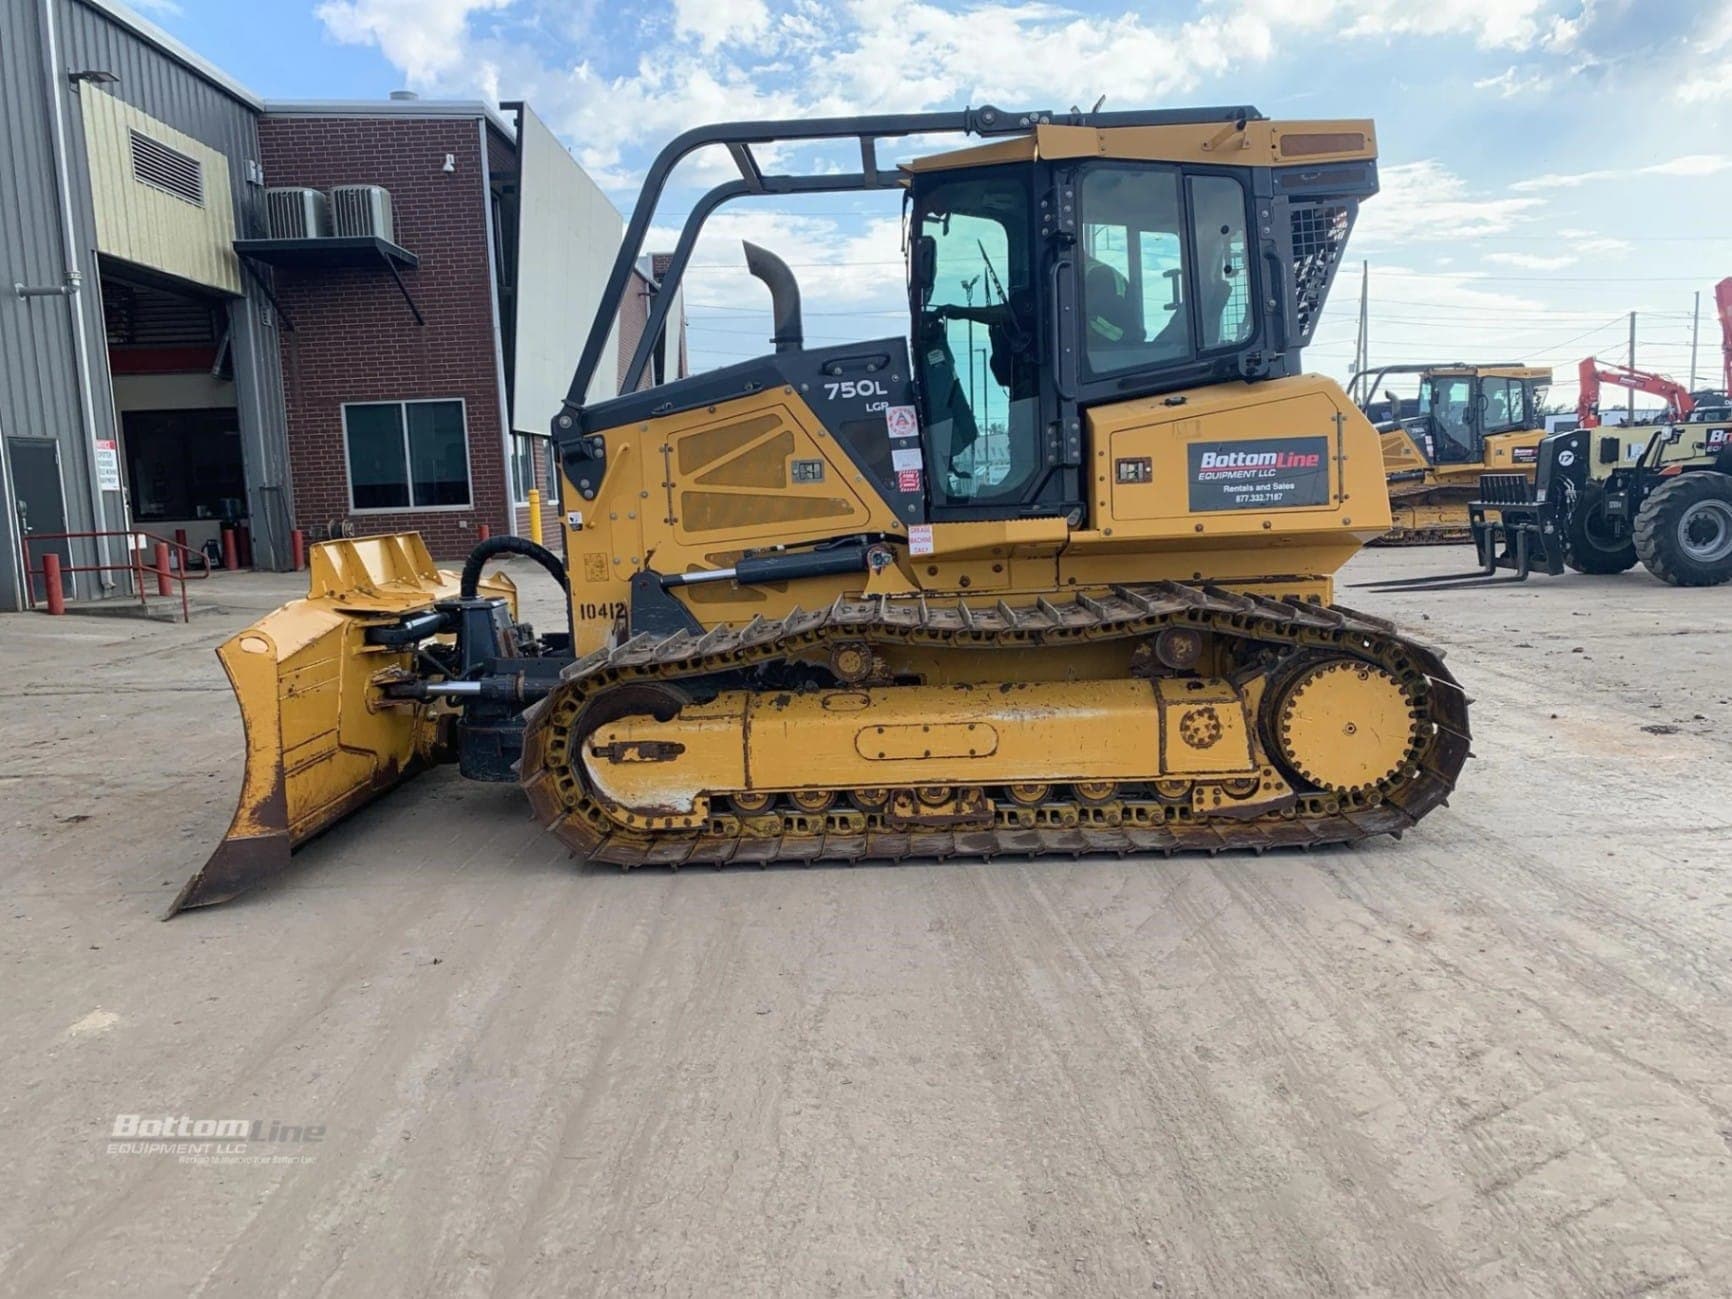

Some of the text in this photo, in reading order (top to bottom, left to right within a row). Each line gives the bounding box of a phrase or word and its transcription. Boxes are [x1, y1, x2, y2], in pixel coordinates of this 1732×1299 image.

[824, 380, 888, 400] 750L
[1200, 452, 1319, 469] BottomLine
[1198, 469, 1276, 480] EQUIPMENT LLC
[1223, 482, 1295, 493] Rentals and Sales
[580, 602, 626, 620] 10412
